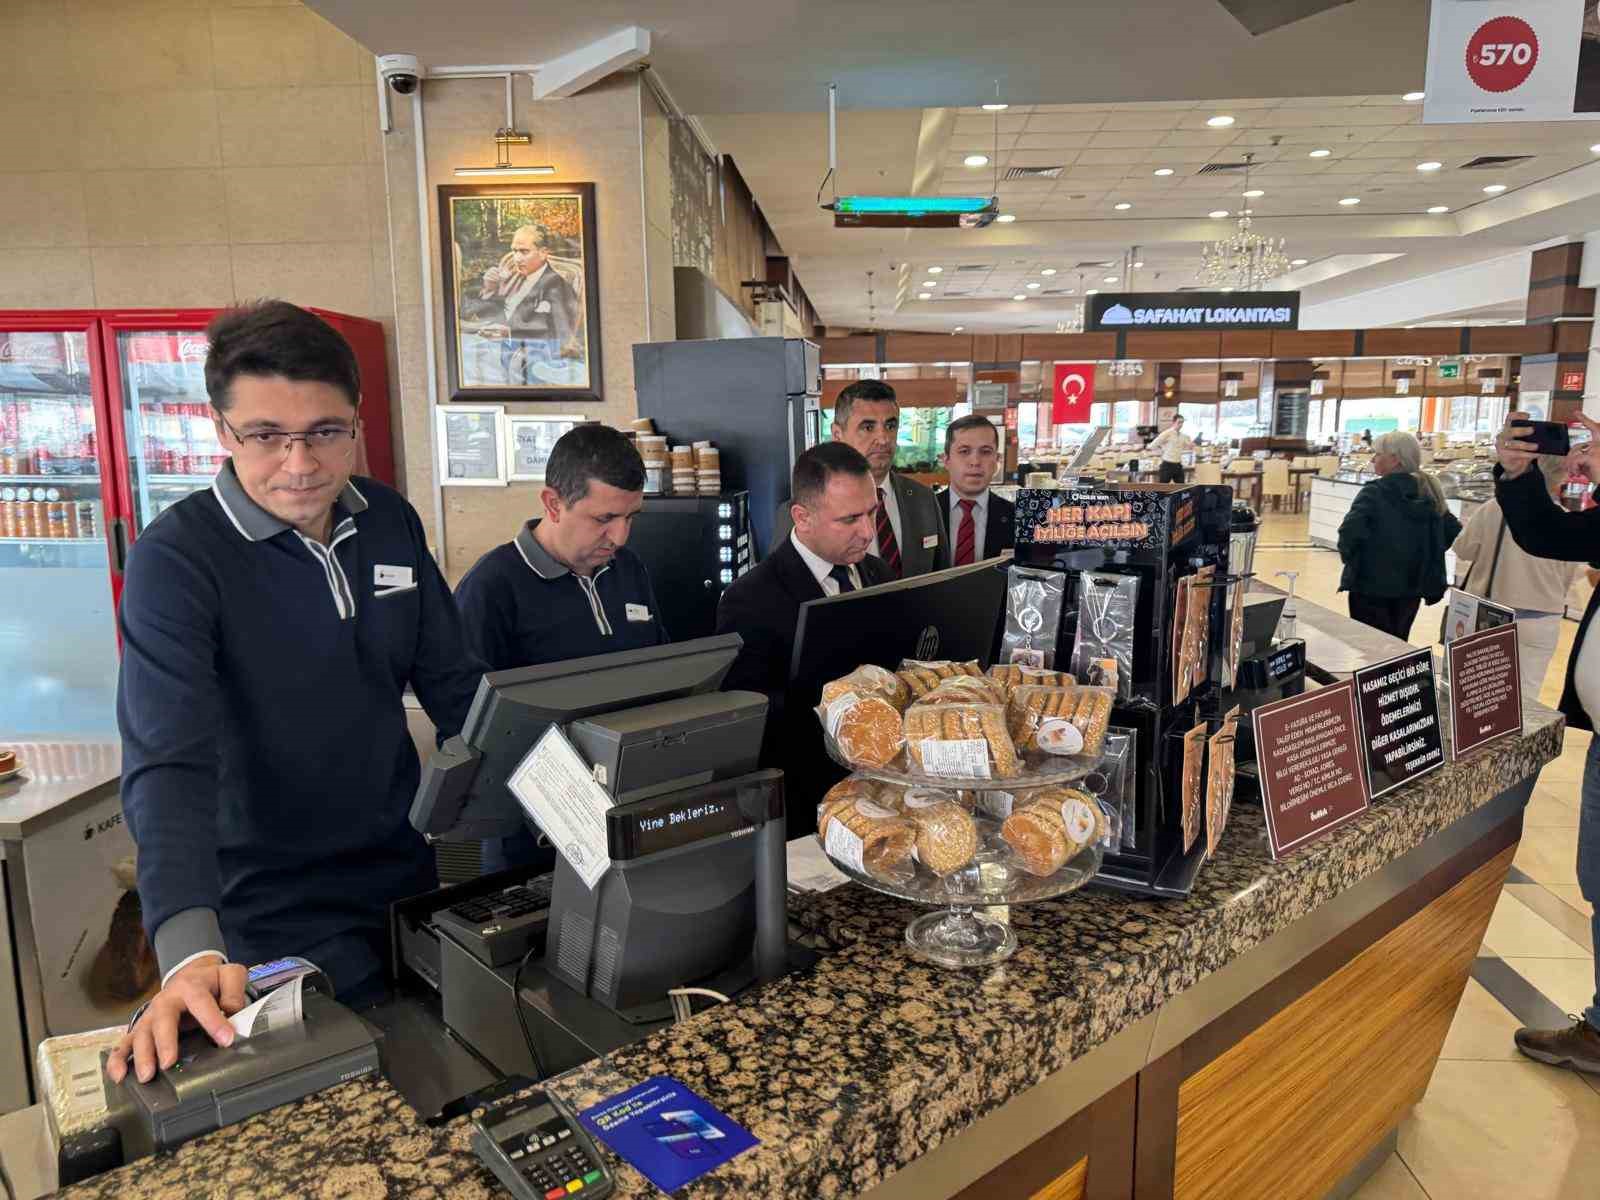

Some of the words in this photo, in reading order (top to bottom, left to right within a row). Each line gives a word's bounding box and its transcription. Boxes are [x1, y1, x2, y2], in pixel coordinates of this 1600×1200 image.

[1133, 308, 1204, 324] SAFAHAT
[1205, 307, 1291, 323] LOKANTASI
[1047, 506, 1084, 523] HER
[1362, 676, 1388, 694] KASAMIZ
[1378, 690, 1399, 707] HİZMET
[640, 818, 664, 832] Yine
[669, 804, 725, 825] Bekleriz..
